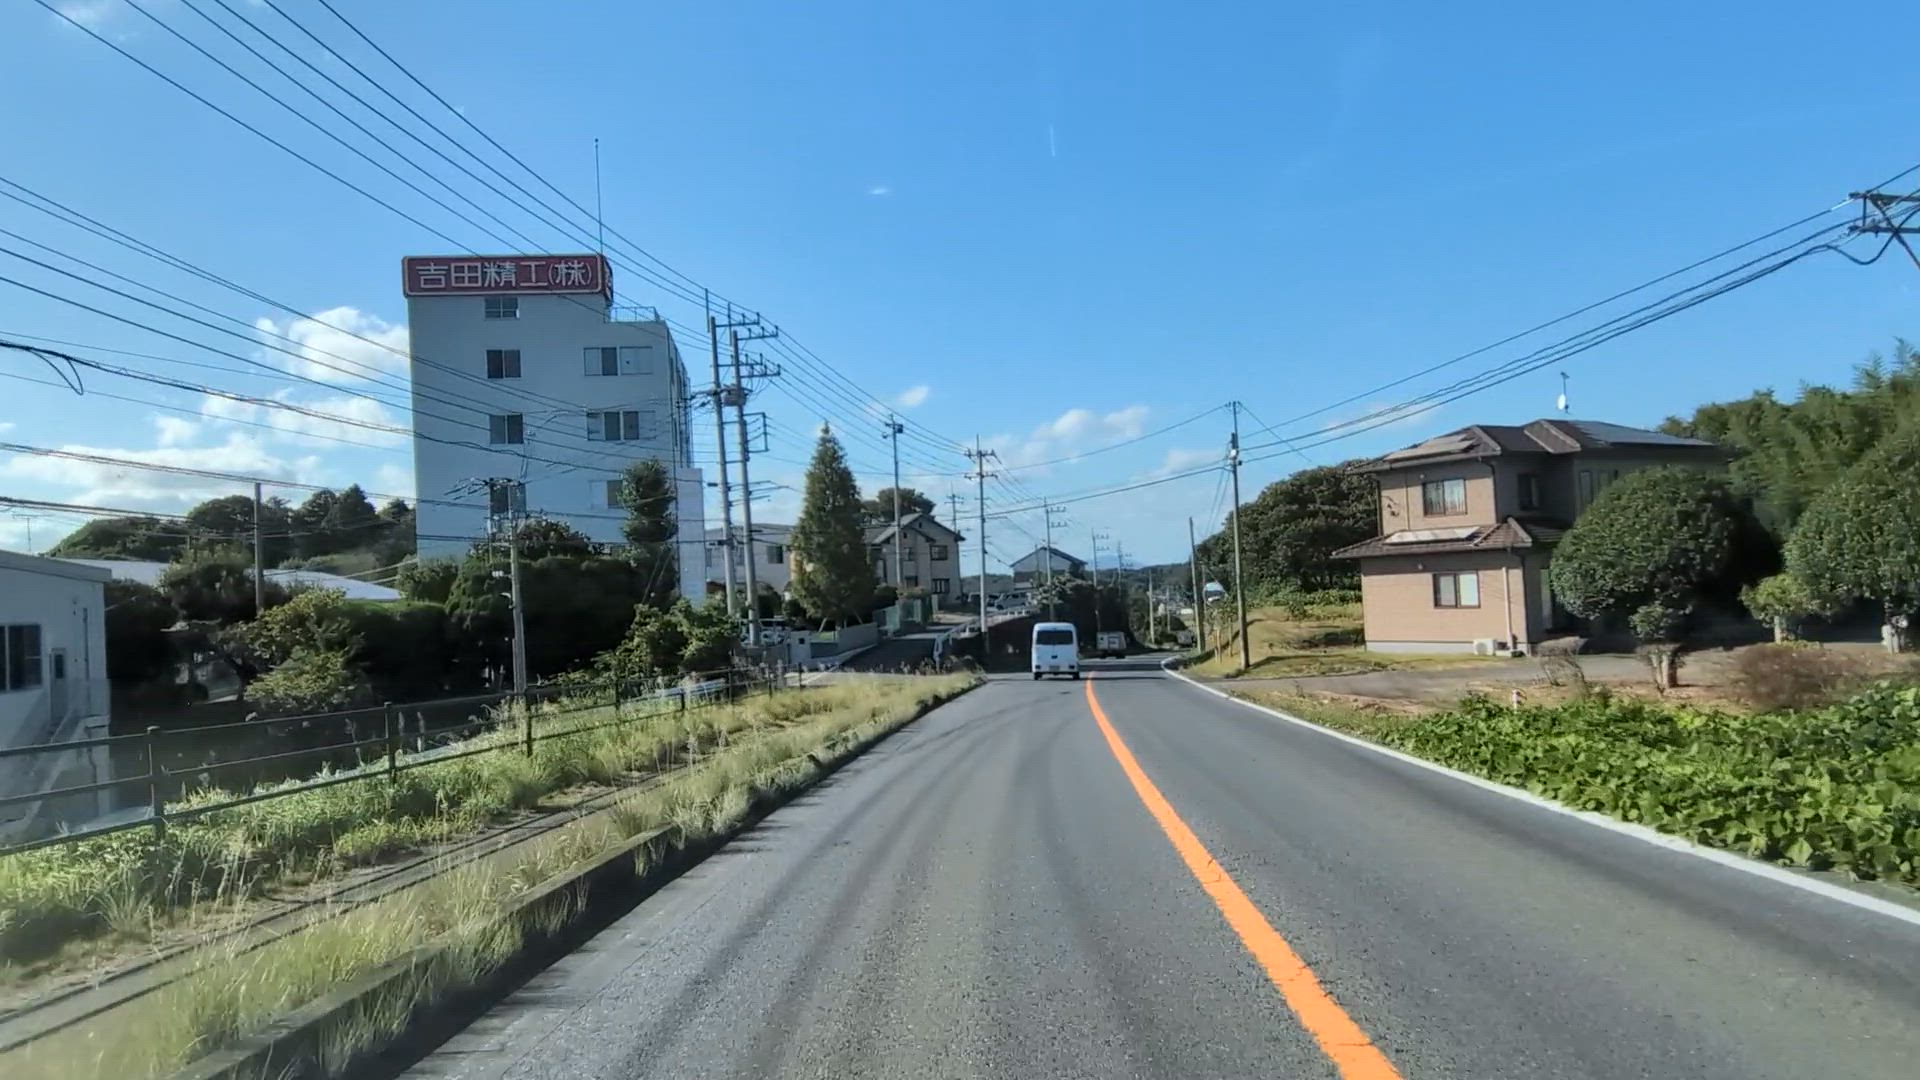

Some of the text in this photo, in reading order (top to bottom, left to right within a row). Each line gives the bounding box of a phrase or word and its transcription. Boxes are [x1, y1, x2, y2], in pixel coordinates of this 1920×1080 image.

[416, 261, 592, 288] 吉田精工(株)
